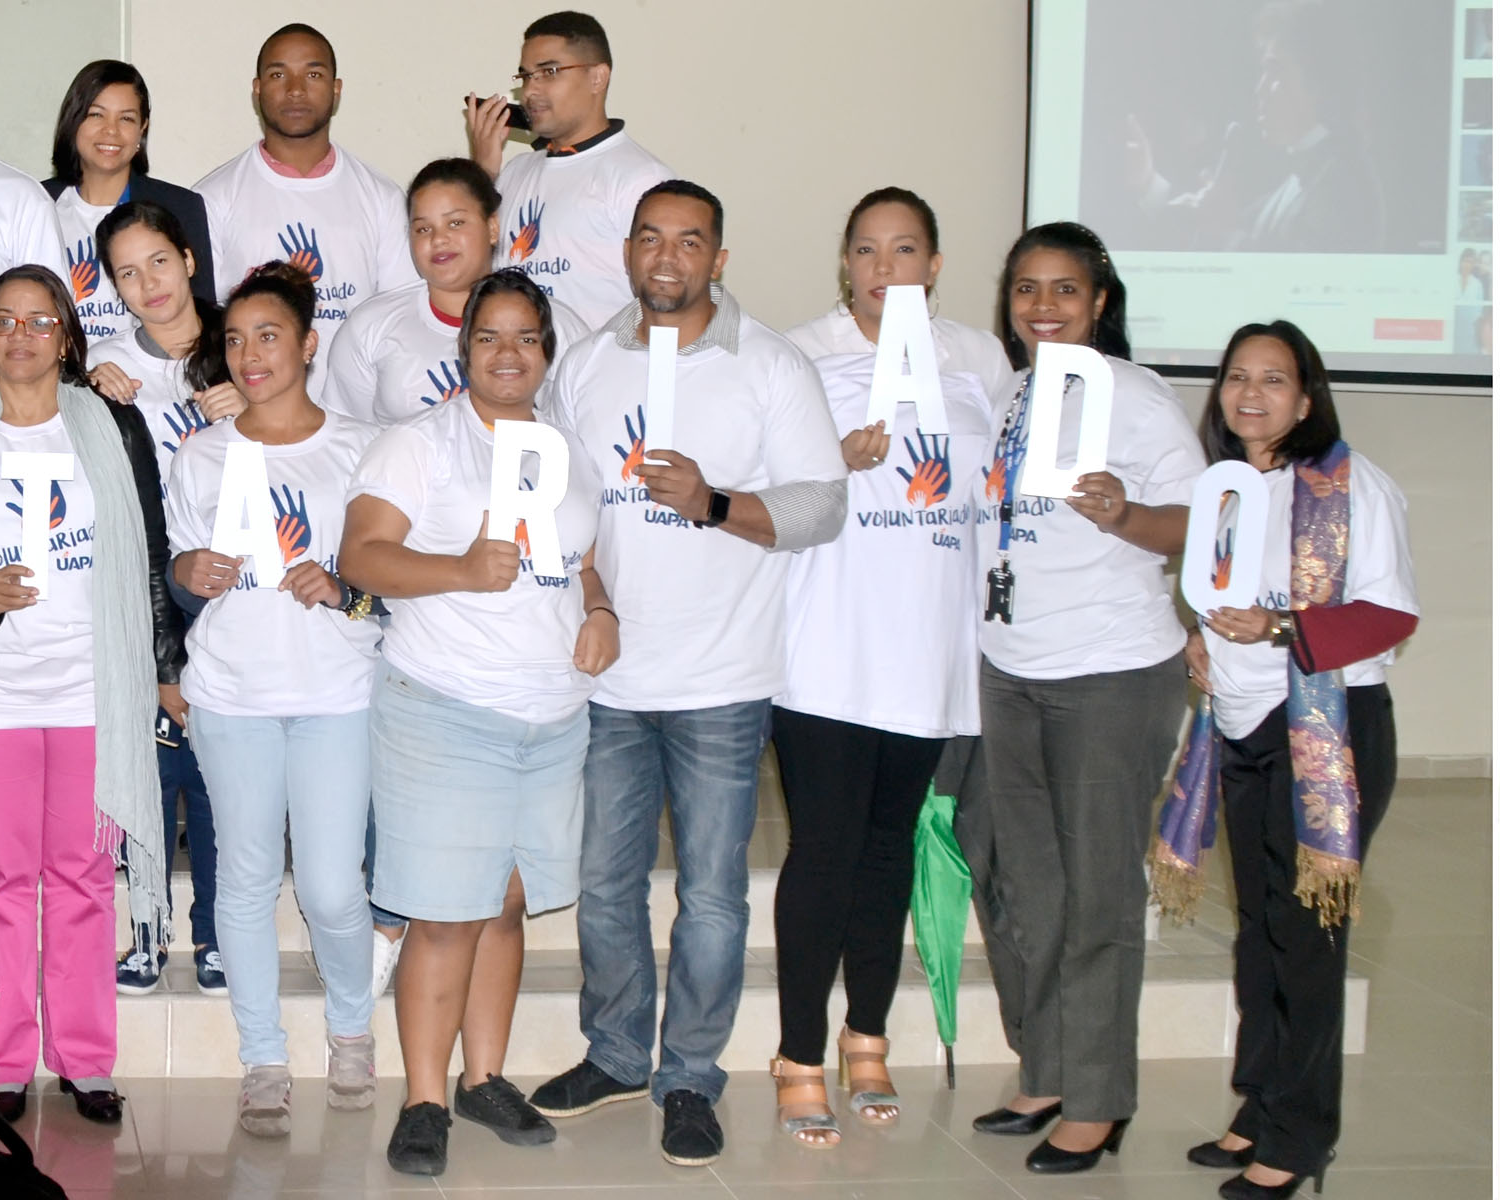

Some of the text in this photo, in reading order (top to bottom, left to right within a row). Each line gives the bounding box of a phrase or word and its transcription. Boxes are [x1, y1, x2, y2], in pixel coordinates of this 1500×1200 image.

[1, 451, 75, 601] T
[211, 441, 286, 589] A
[487, 419, 570, 579] R
[866, 284, 949, 435] A
[1020, 341, 1115, 501] D
[645, 509, 689, 529] UAPA
